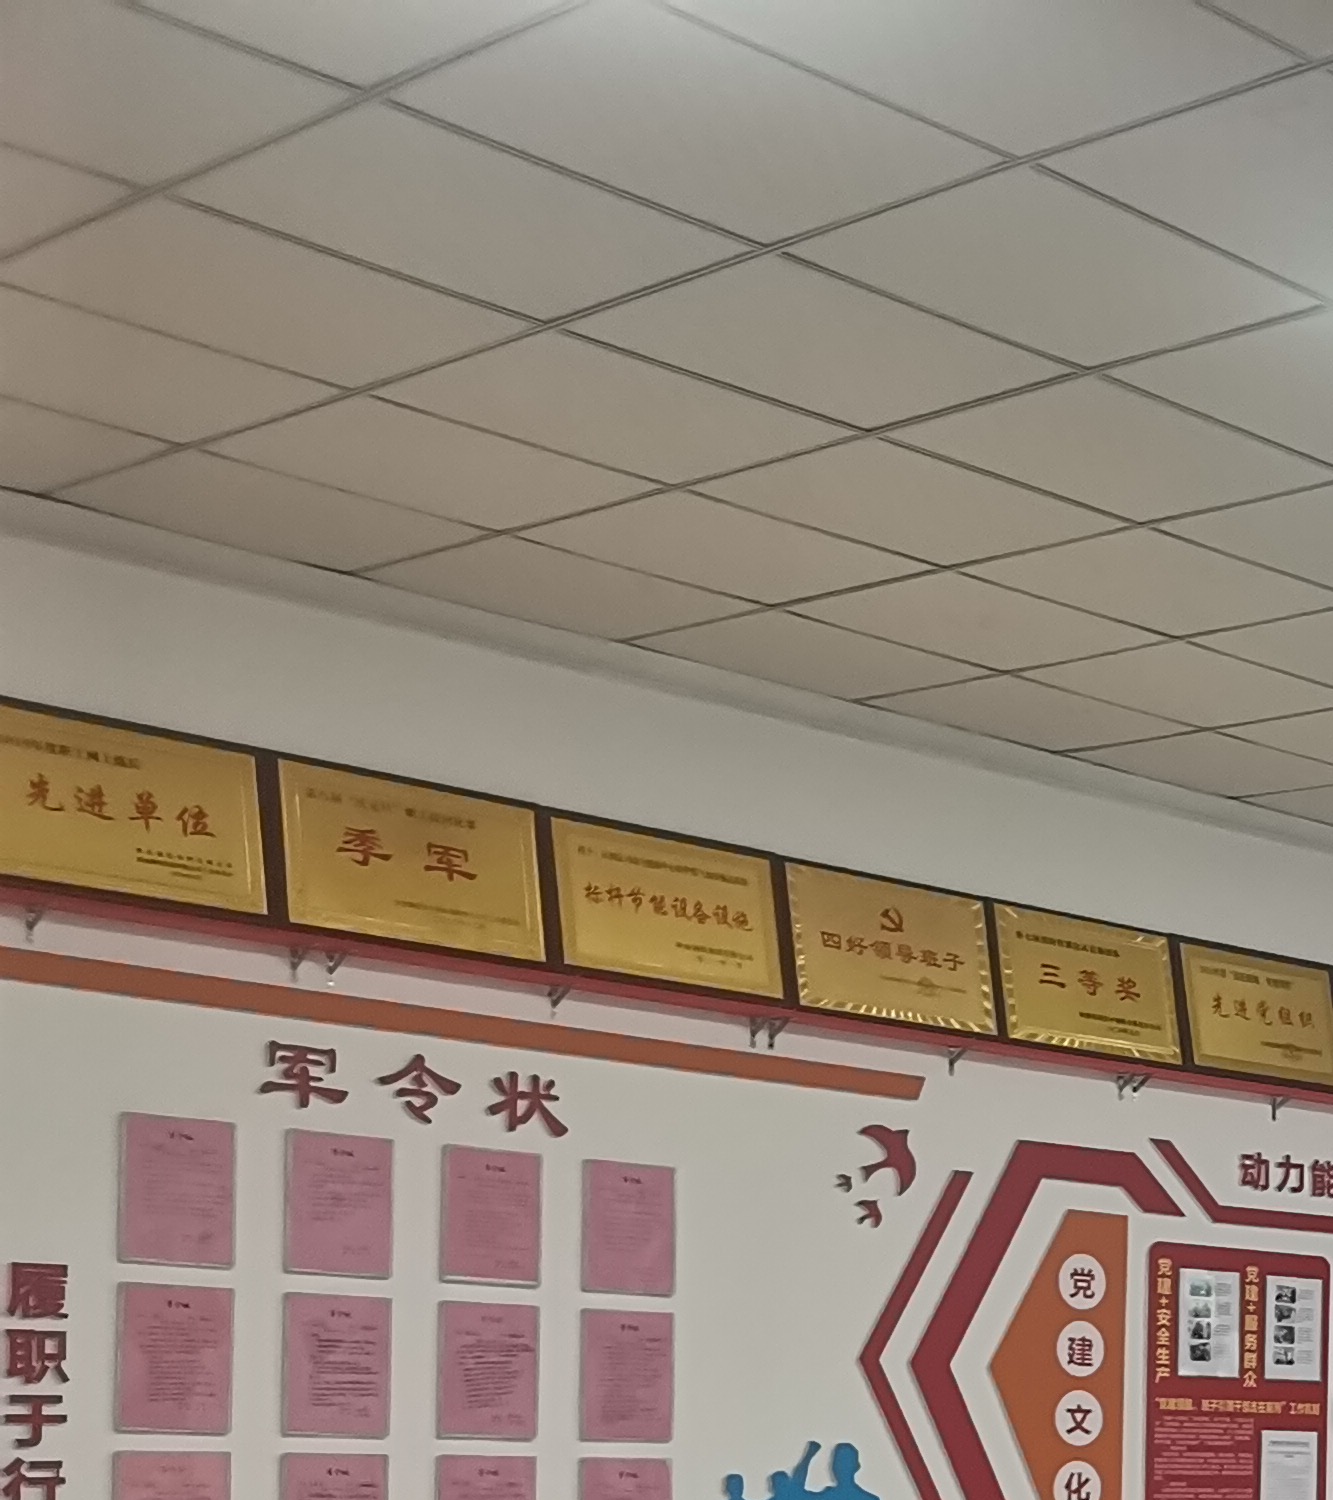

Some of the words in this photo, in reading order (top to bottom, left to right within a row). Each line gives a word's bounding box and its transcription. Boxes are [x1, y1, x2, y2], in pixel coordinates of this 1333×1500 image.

[26, 772, 217, 838] 先进单位
[335, 826, 479, 882] 季军
[819, 930, 966, 971] 四好领导班子
[1038, 962, 1141, 1004] 三等奖
[258, 1039, 569, 1137] 军令状
